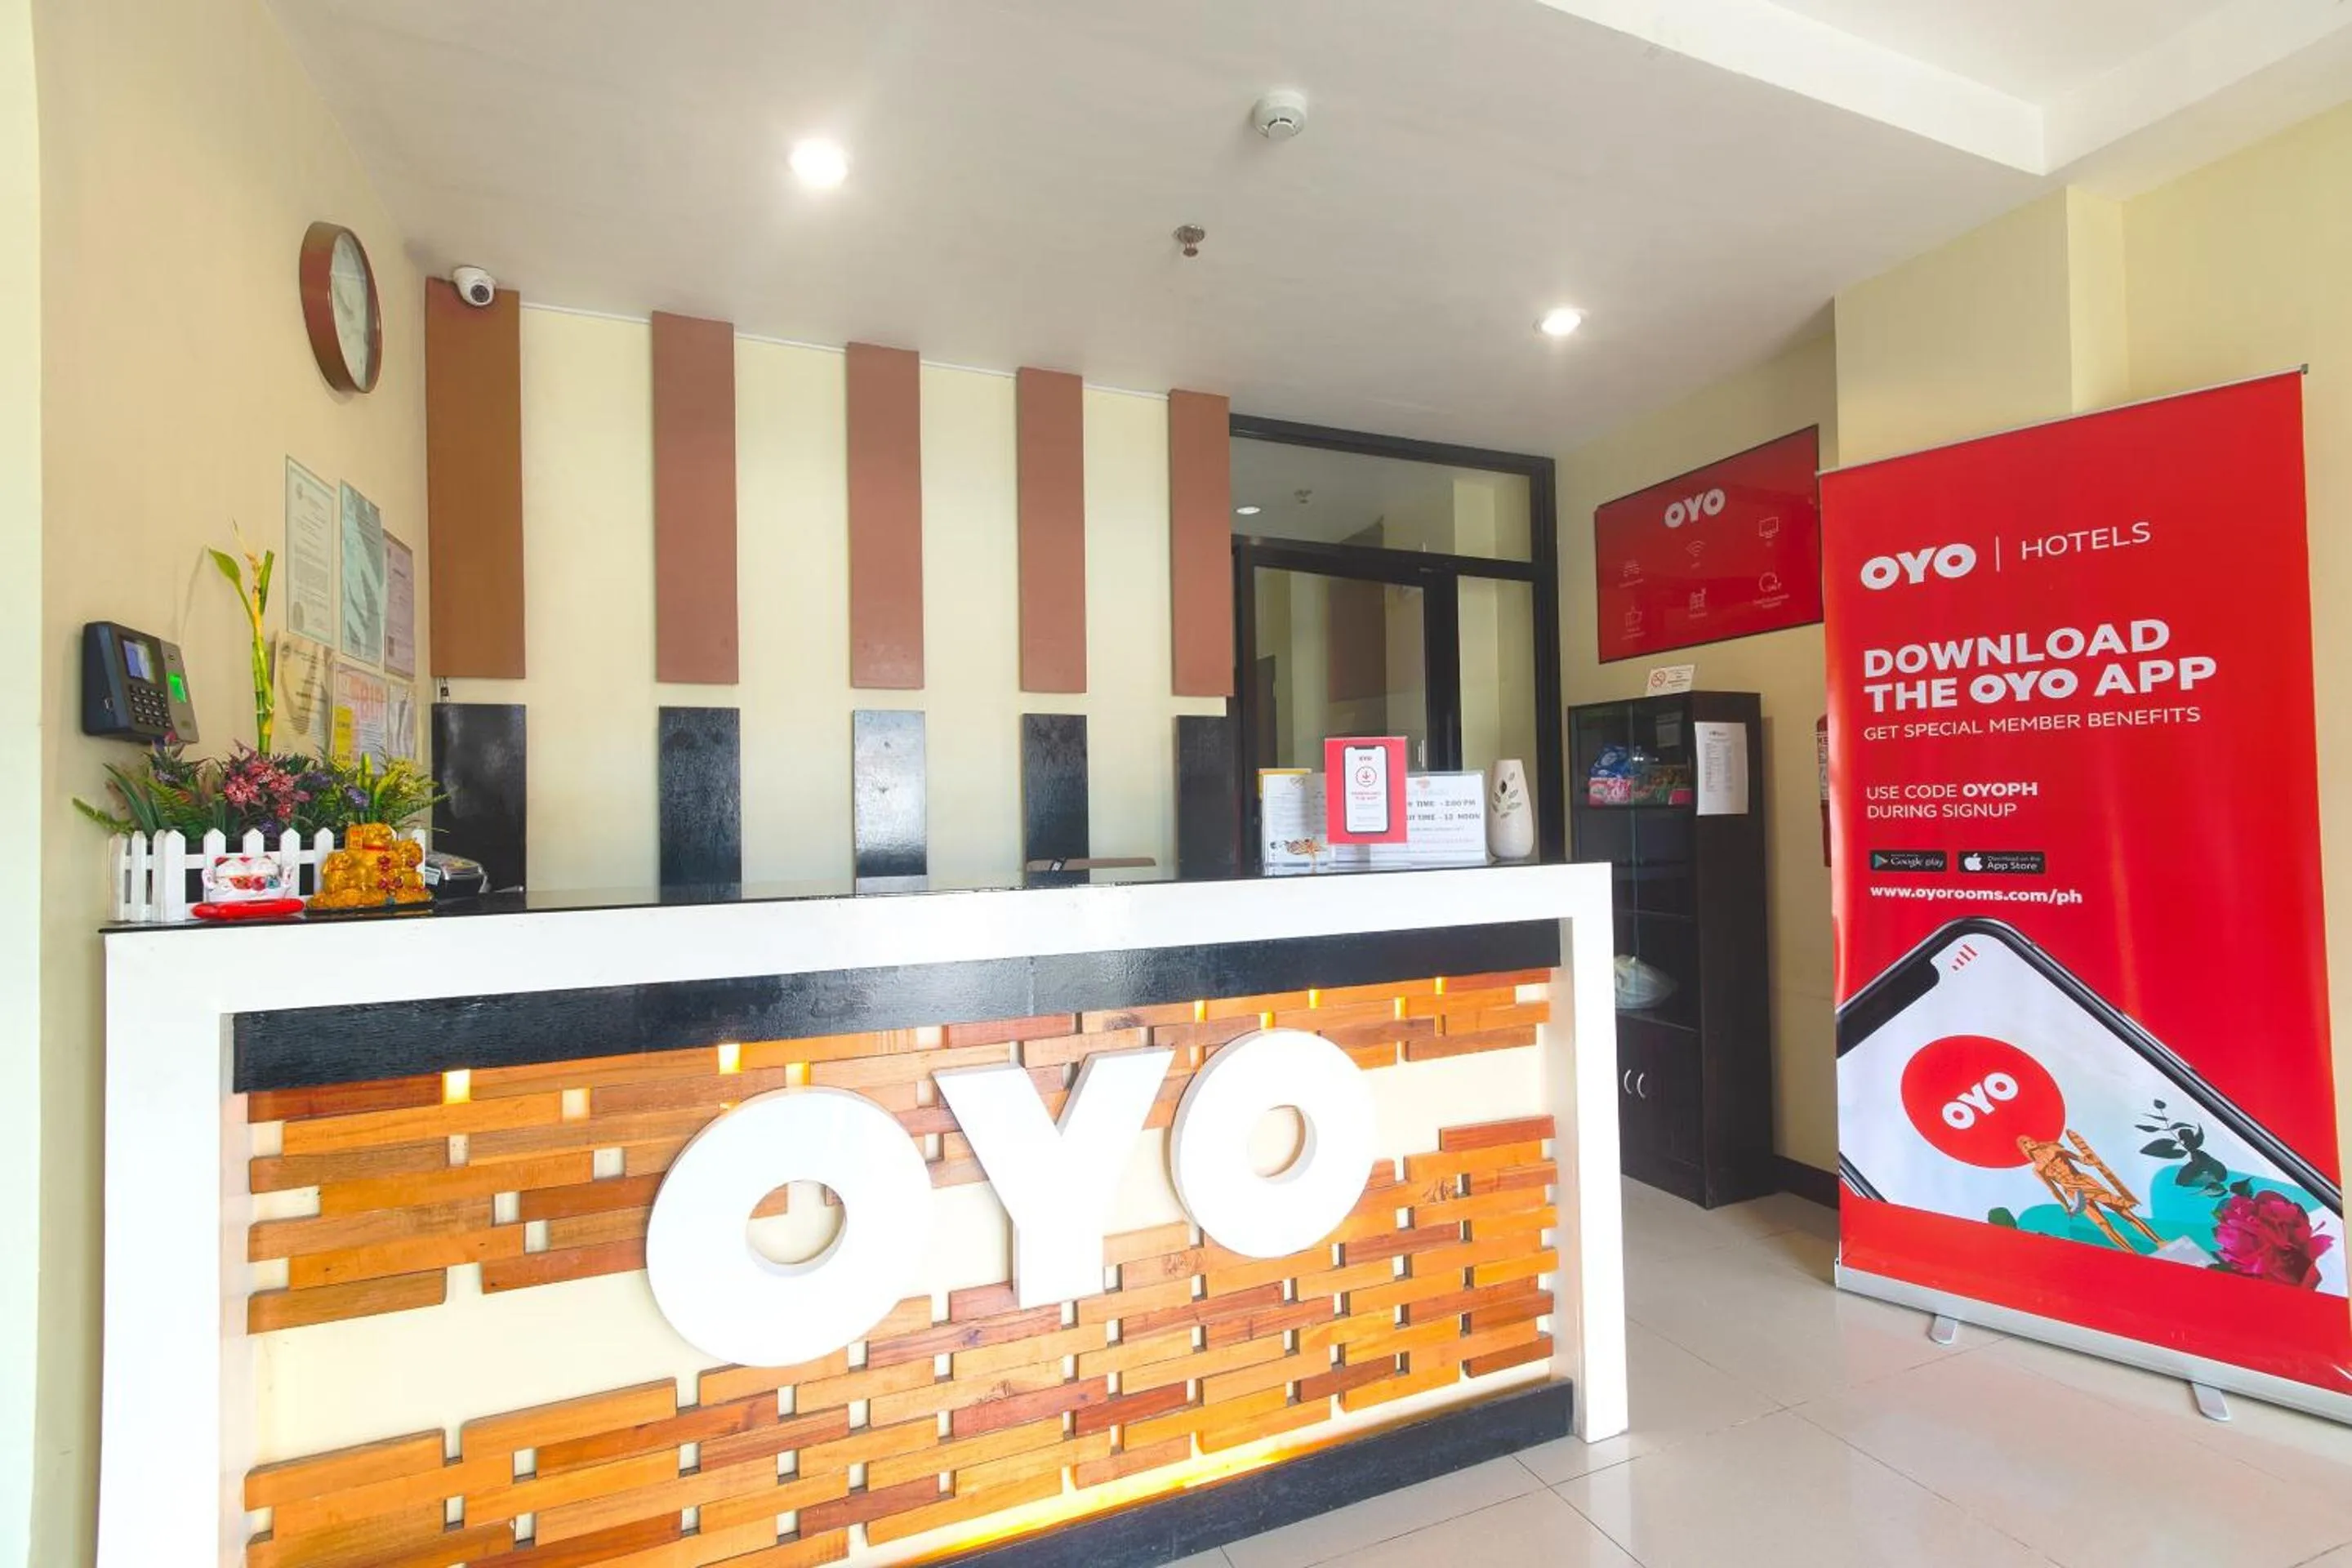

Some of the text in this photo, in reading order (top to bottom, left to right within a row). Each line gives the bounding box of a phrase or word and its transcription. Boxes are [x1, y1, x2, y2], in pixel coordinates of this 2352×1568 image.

[1664, 488, 1725, 528] OYO
[1860, 522, 2151, 590] OYO HOTELS
[1864, 619, 2170, 678] DOWNLOAD
[1864, 656, 2216, 712] THE OYO APP
[1864, 706, 2201, 740] GET SPECIAL MEMBER BENEFITS
[1866, 782, 2038, 800] USE CODE OYOPH
[1867, 802, 2017, 818] DURING SIGNUP
[1891, 858, 1944, 869] Google play
[1987, 862, 2038, 871] App Store
[1869, 884, 2083, 905] www.oyorooms.com/ph
[1941, 1071, 2019, 1130] OYO
[644, 1027, 1377, 1368] OYO
